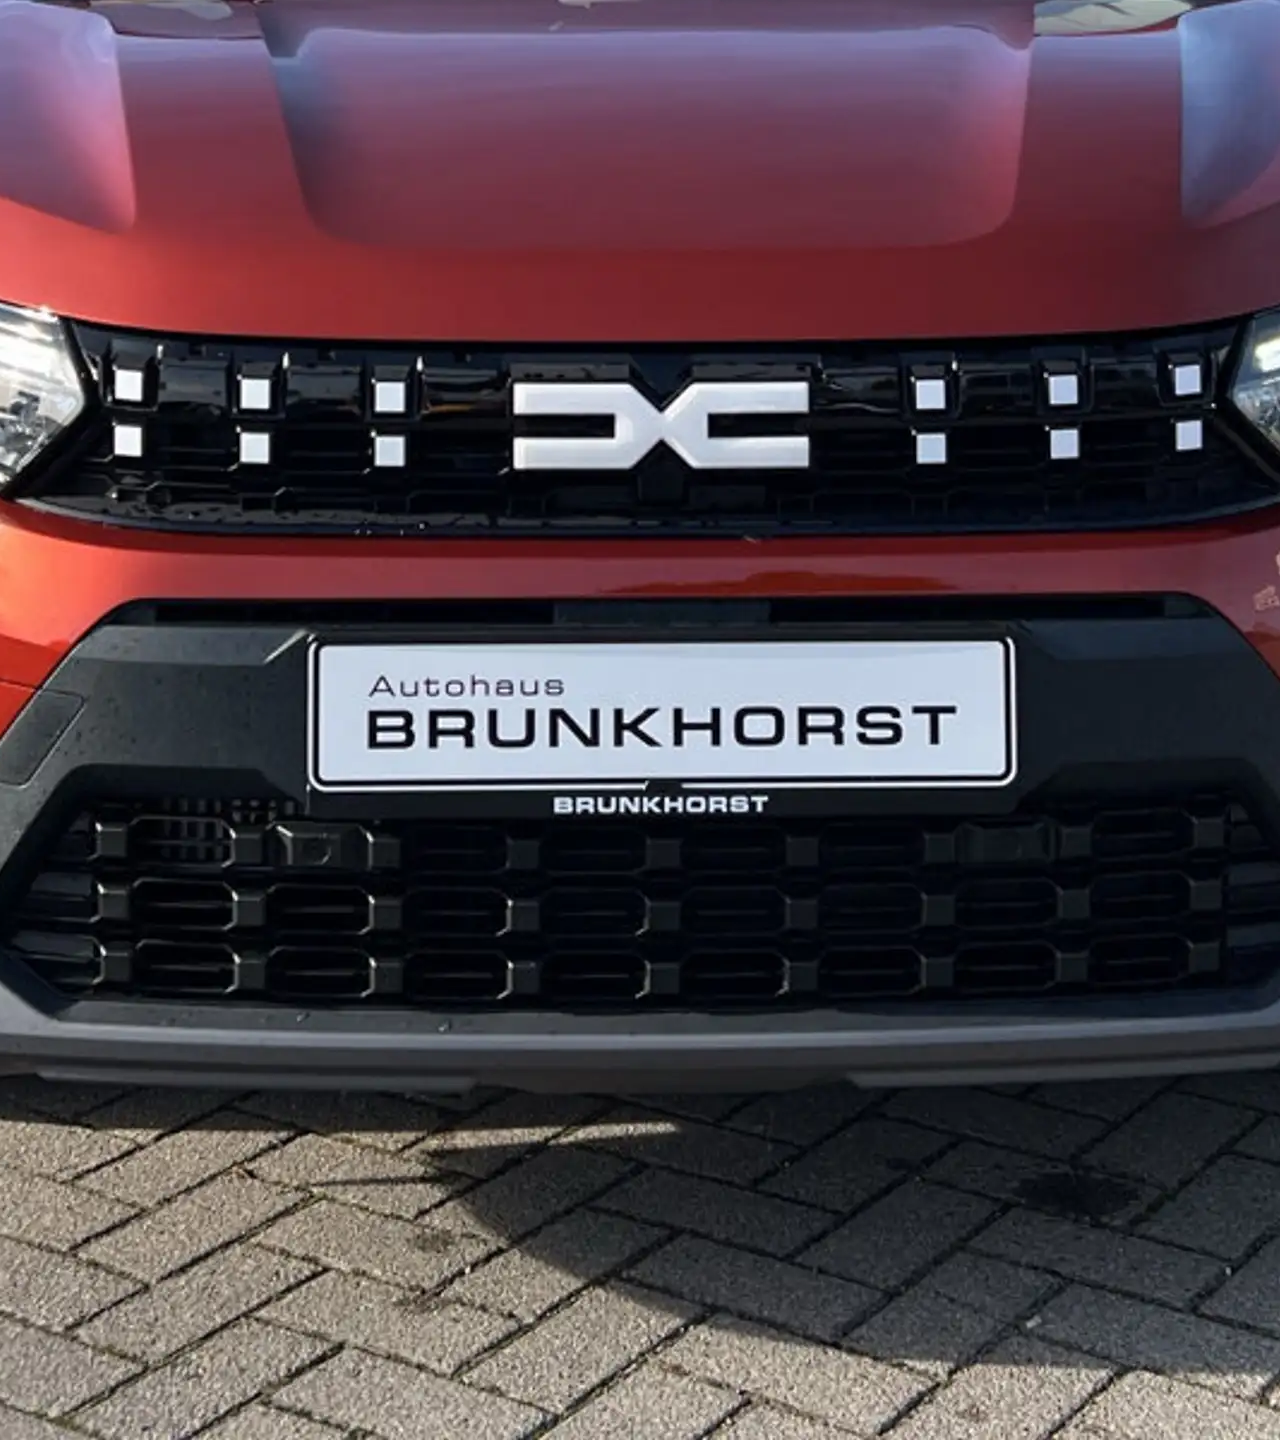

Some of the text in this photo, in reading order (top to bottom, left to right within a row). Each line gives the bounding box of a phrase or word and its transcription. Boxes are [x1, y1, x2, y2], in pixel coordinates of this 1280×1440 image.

[368, 675, 565, 697] Autohaus
[367, 705, 957, 750] BRUNKHORST
[553, 795, 769, 815] BRUNKHORST
